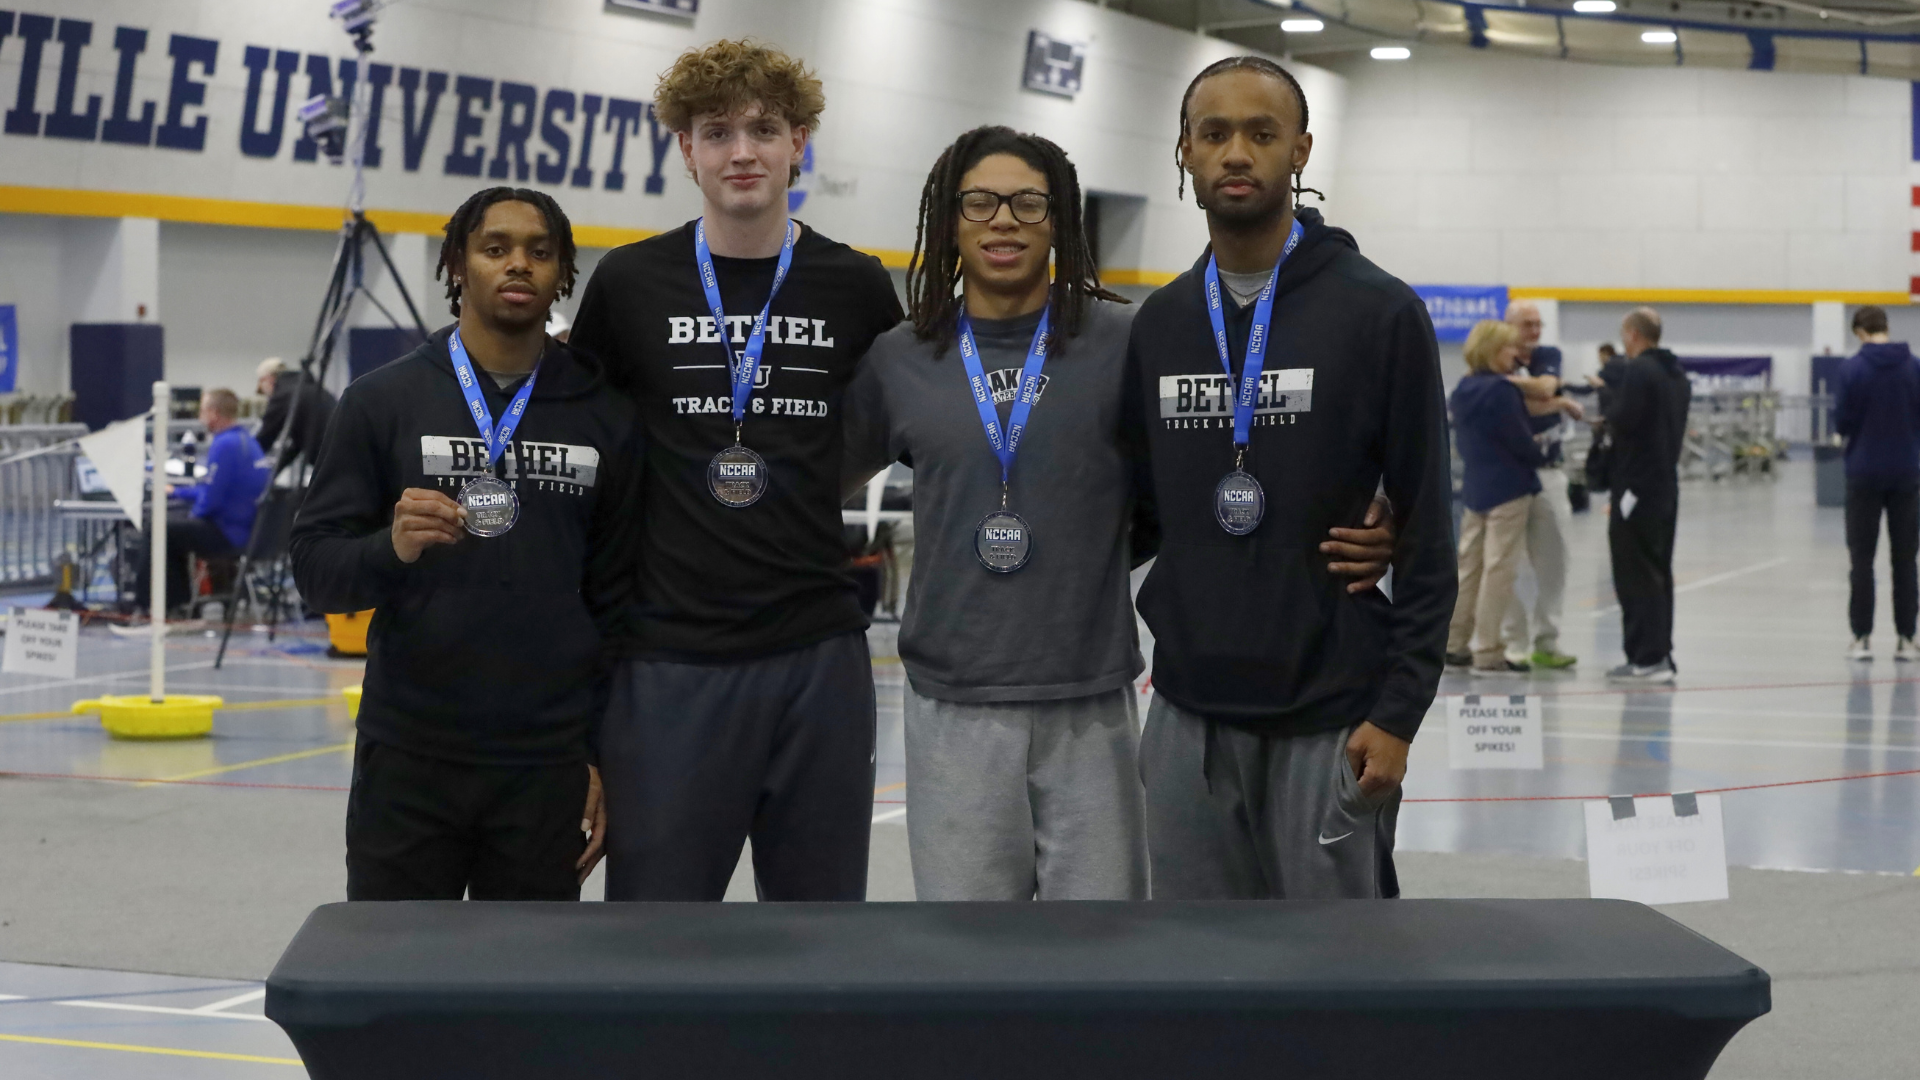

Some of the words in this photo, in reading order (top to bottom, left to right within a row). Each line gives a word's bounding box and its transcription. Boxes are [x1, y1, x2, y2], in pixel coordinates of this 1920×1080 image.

[239, 43, 676, 196] UNIVERSITY
[702, 261, 715, 288] NCCAA
[1209, 281, 1220, 310] NCCAA
[668, 315, 834, 348] BETHEL
[1251, 324, 1264, 354] NCCAA
[1218, 330, 1227, 360] NCCAA
[458, 365, 474, 389] NCCAA
[741, 356, 755, 384] NCCAA
[972, 375, 987, 403] NCCAA
[1020, 375, 1036, 404] NCCAA
[1176, 373, 1287, 413] BETEL
[1242, 377, 1255, 407] NCCAA
[471, 399, 485, 420] NCCAA
[511, 398, 526, 416] NCCAA
[752, 398, 765, 414] &
[771, 398, 828, 417] FIELD
[1166, 419, 1209, 430] TRACK
[1218, 417, 1236, 429] AN
[1253, 414, 1296, 427] FIELD
[498, 425, 512, 445] NCCAA
[987, 421, 1003, 451] NCCAA
[1009, 423, 1023, 453] NCCAA
[720, 464, 756, 476] NCCAA
[468, 493, 506, 507] NCCAA
[539, 481, 584, 496] FIELD
[1224, 490, 1254, 502] NCCAA
[985, 528, 1021, 540] NCCAA
[1459, 708, 1498, 718] PLEASE
[1502, 708, 1528, 719] TAKE
[1467, 725, 1488, 735] OFF
[1490, 725, 1522, 735] YOUR
[1474, 742, 1516, 753] SPIKES!
